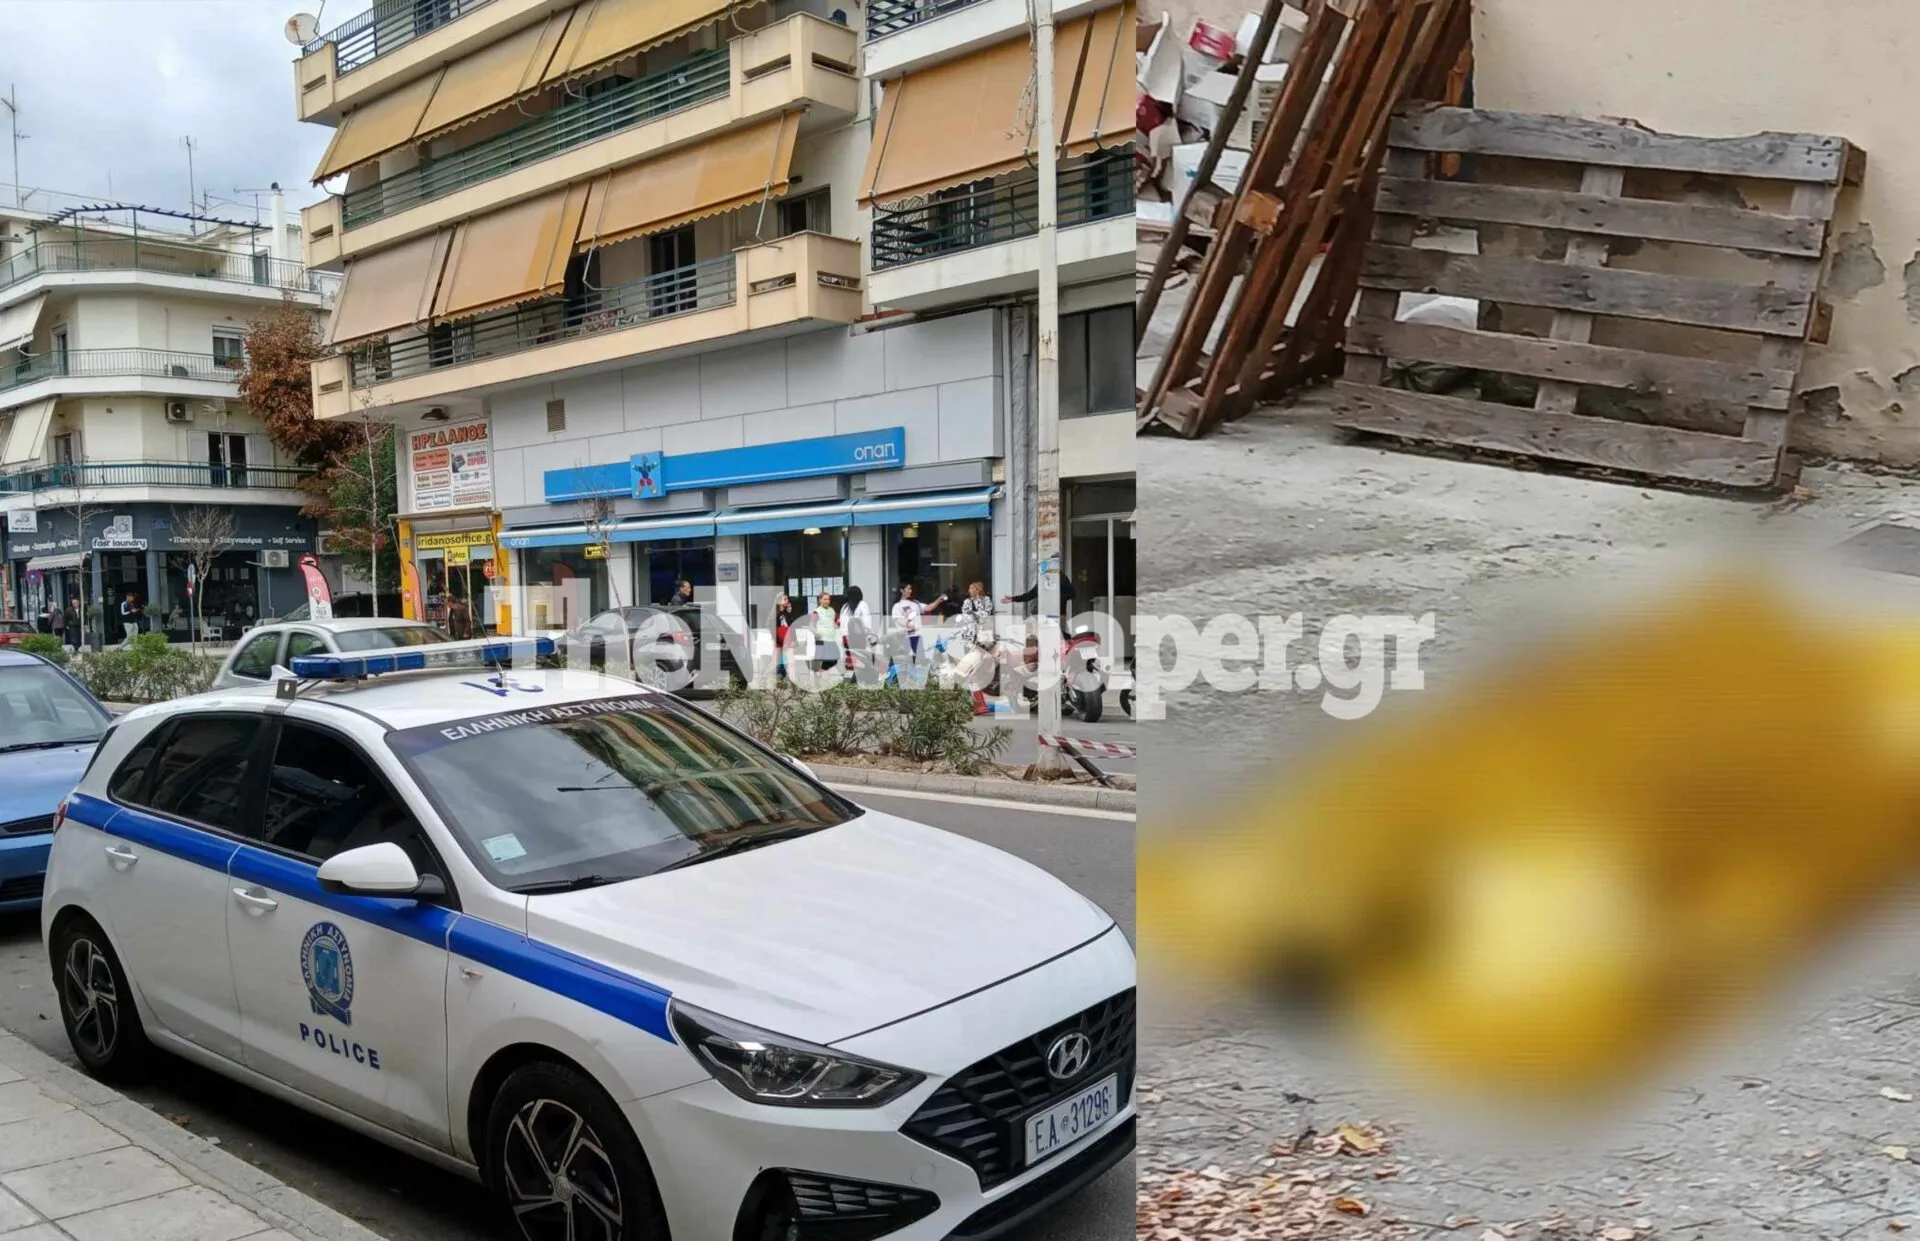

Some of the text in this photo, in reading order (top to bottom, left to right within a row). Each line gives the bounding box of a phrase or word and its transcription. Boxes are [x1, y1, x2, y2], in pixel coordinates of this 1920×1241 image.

[93, 538, 111, 548] fast
[112, 538, 146, 549] laundry
[418, 532, 493, 546] iridanosoffice.g
[440, 699, 658, 740] ΕΛΛΗΝΙΚΗ ΑΣΤΥΝΟΜΙΑ
[299, 1022, 381, 1070] POLICE
[1071, 1086, 1109, 1134] 31296
